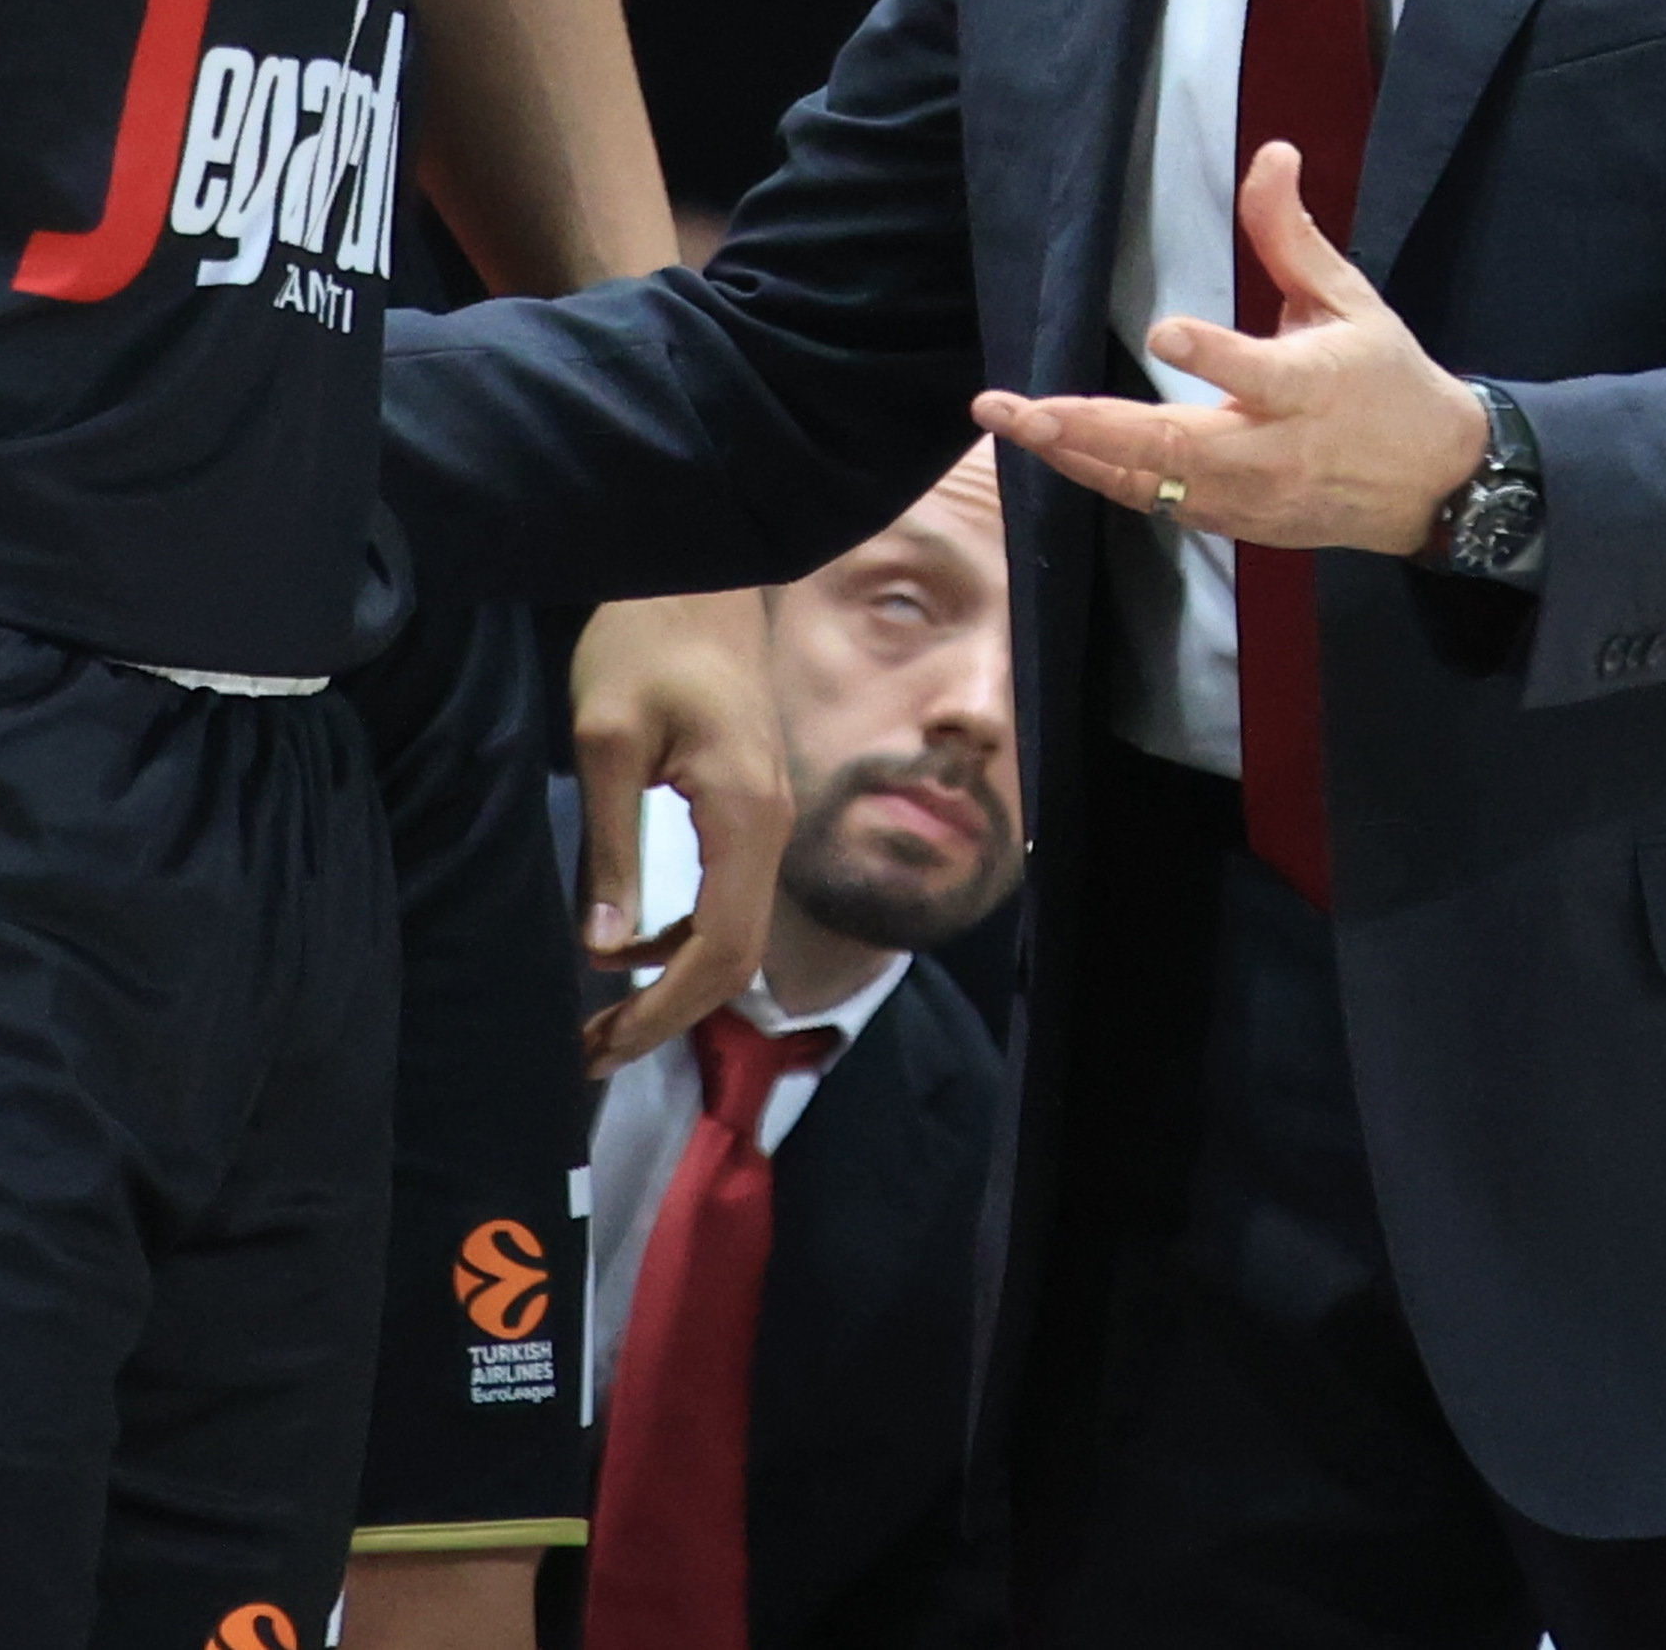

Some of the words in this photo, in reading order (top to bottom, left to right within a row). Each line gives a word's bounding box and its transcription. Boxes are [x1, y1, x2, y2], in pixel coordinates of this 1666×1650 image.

[466, 1340, 553, 1364] TURKISH
[470, 1361, 555, 1386] AIRLINES
[469, 1384, 557, 1404] EuroLeague
